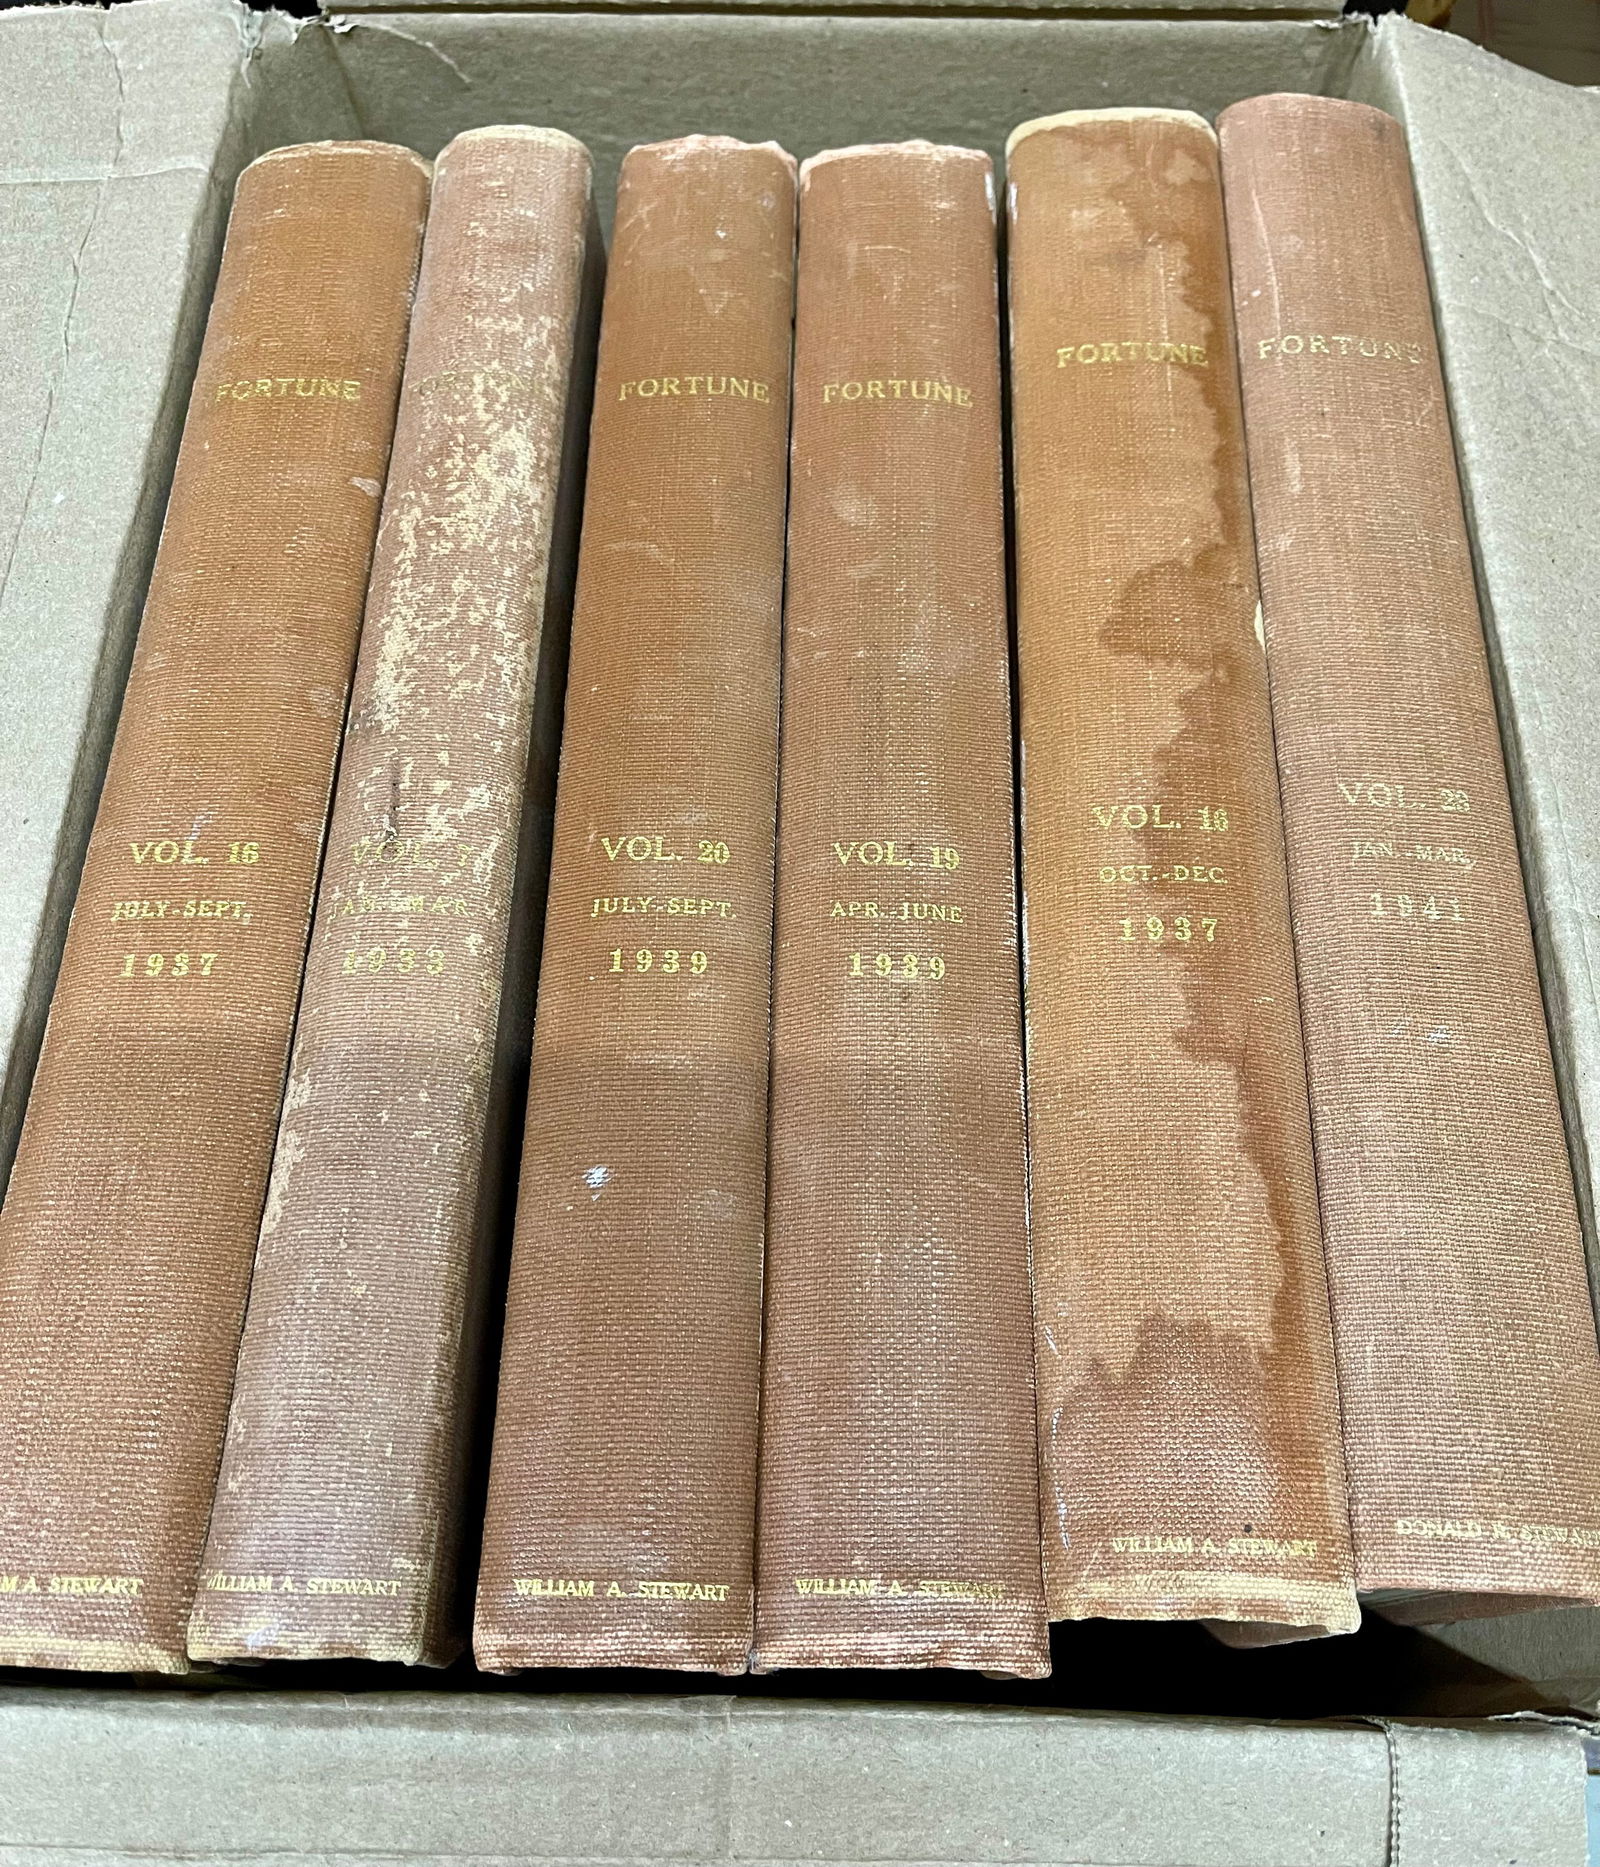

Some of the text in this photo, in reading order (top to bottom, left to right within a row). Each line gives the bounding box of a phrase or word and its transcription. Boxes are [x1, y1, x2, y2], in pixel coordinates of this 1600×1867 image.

[1056, 339, 1208, 368] FORTUNE
[214, 376, 361, 401] FORTUNE
[617, 375, 771, 403] FORTUNE
[822, 379, 974, 408] FORTUNE
[1337, 782, 1426, 809] VOL.
[1092, 804, 1229, 832] VOL. 16
[128, 840, 210, 865] VOL.
[601, 836, 730, 864] VOL. 20
[832, 840, 960, 870] VOL. 19
[591, 896, 737, 918] JULY-SEPT.
[830, 901, 964, 924] APR.-JUNE
[1119, 916, 1218, 942] 1937
[609, 948, 708, 974] 1939
[849, 952, 946, 981] 1939
[1112, 1537, 1193, 1553] WILLIAM
[1227, 1538, 1318, 1558] STEWART
[48, 1575, 144, 1597] STEWART
[207, 1574, 274, 1592] WILLIAM
[305, 1577, 401, 1596] STEWART
[513, 1579, 730, 1601] WILLIAM A. STEWART
[796, 1579, 876, 1596] WILLIAM
